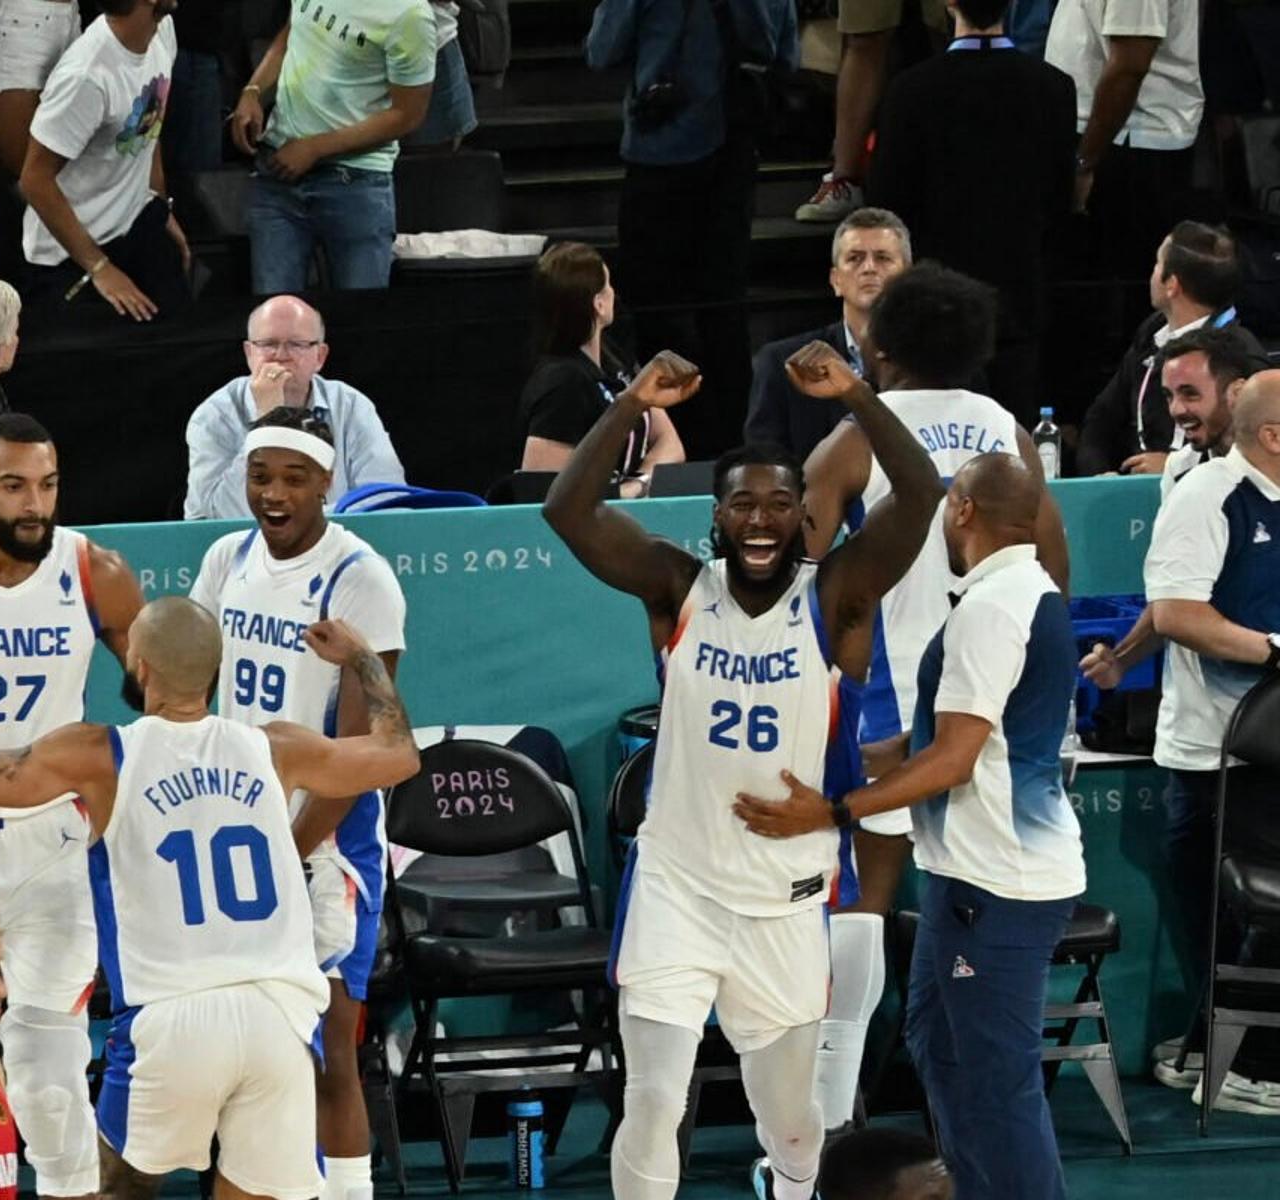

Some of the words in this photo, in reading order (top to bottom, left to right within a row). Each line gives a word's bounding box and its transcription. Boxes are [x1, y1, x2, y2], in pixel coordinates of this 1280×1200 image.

[463, 546, 552, 573] 2024
[223, 608, 308, 653] FRANCE
[235, 658, 286, 713] 99
[695, 643, 800, 684] FRANCE
[709, 699, 779, 752] 26
[144, 767, 265, 816] FOURNIER
[436, 794, 514, 819] 2024
[156, 825, 279, 926] 10
